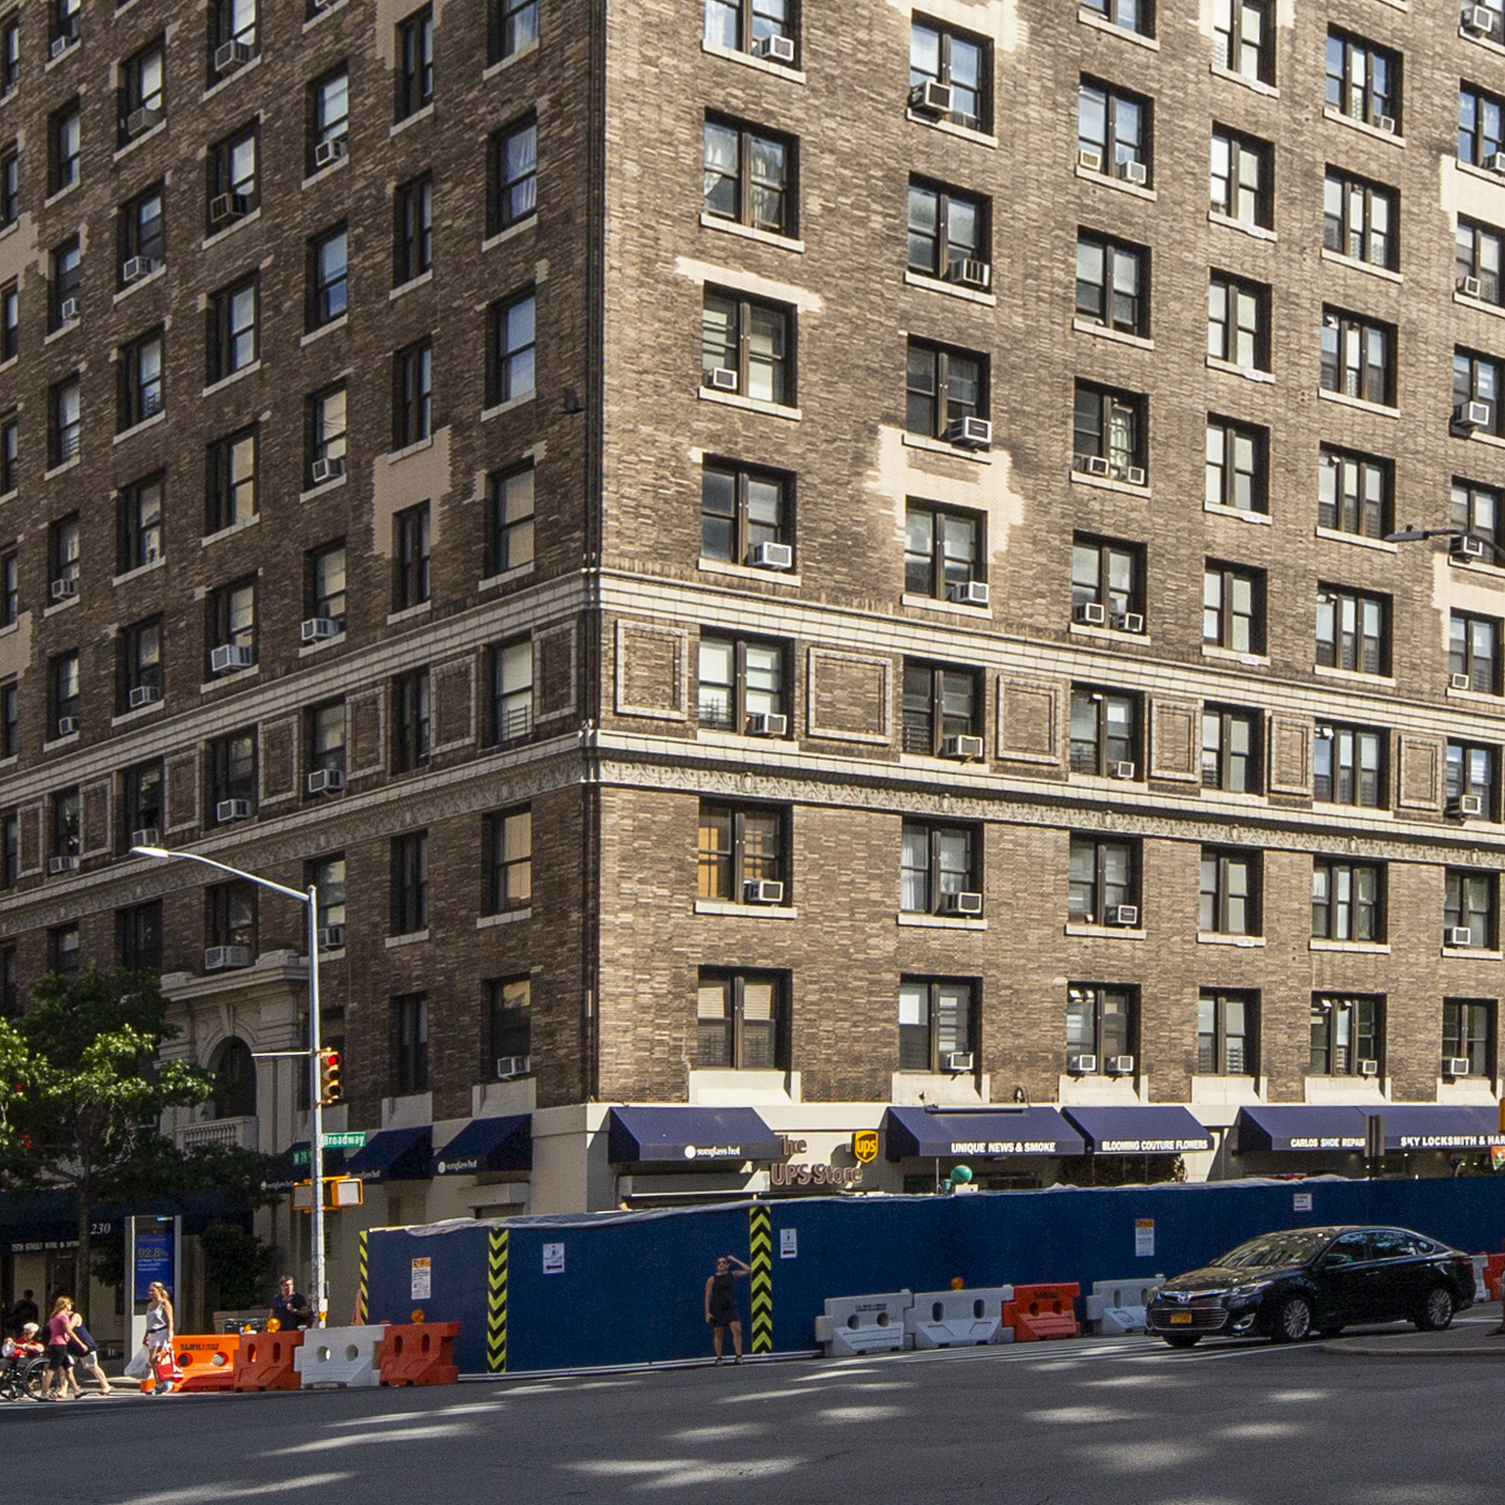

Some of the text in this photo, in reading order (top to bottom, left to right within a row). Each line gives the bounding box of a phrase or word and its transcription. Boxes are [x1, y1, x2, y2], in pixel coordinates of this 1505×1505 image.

[323, 1134, 365, 1147] Broadway
[1102, 1139, 1208, 1151] BLOOMING COUTURE FLOWERS
[1290, 1138, 1319, 1148] CARLOS
[1320, 1138, 1340, 1148] SHOE
[1400, 1136, 1421, 1147] SKY
[1422, 1135, 1477, 1146] LOCKSMITH
[1478, 1135, 1486, 1145] &
[697, 1145, 740, 1158] sunglass hut
[857, 1140, 876, 1157] ups
[951, 1142, 1056, 1154] UNIQUE NEWS & SMOKE
[772, 1163, 863, 1185] UPS Store
[91, 1223, 111, 1235] 230
